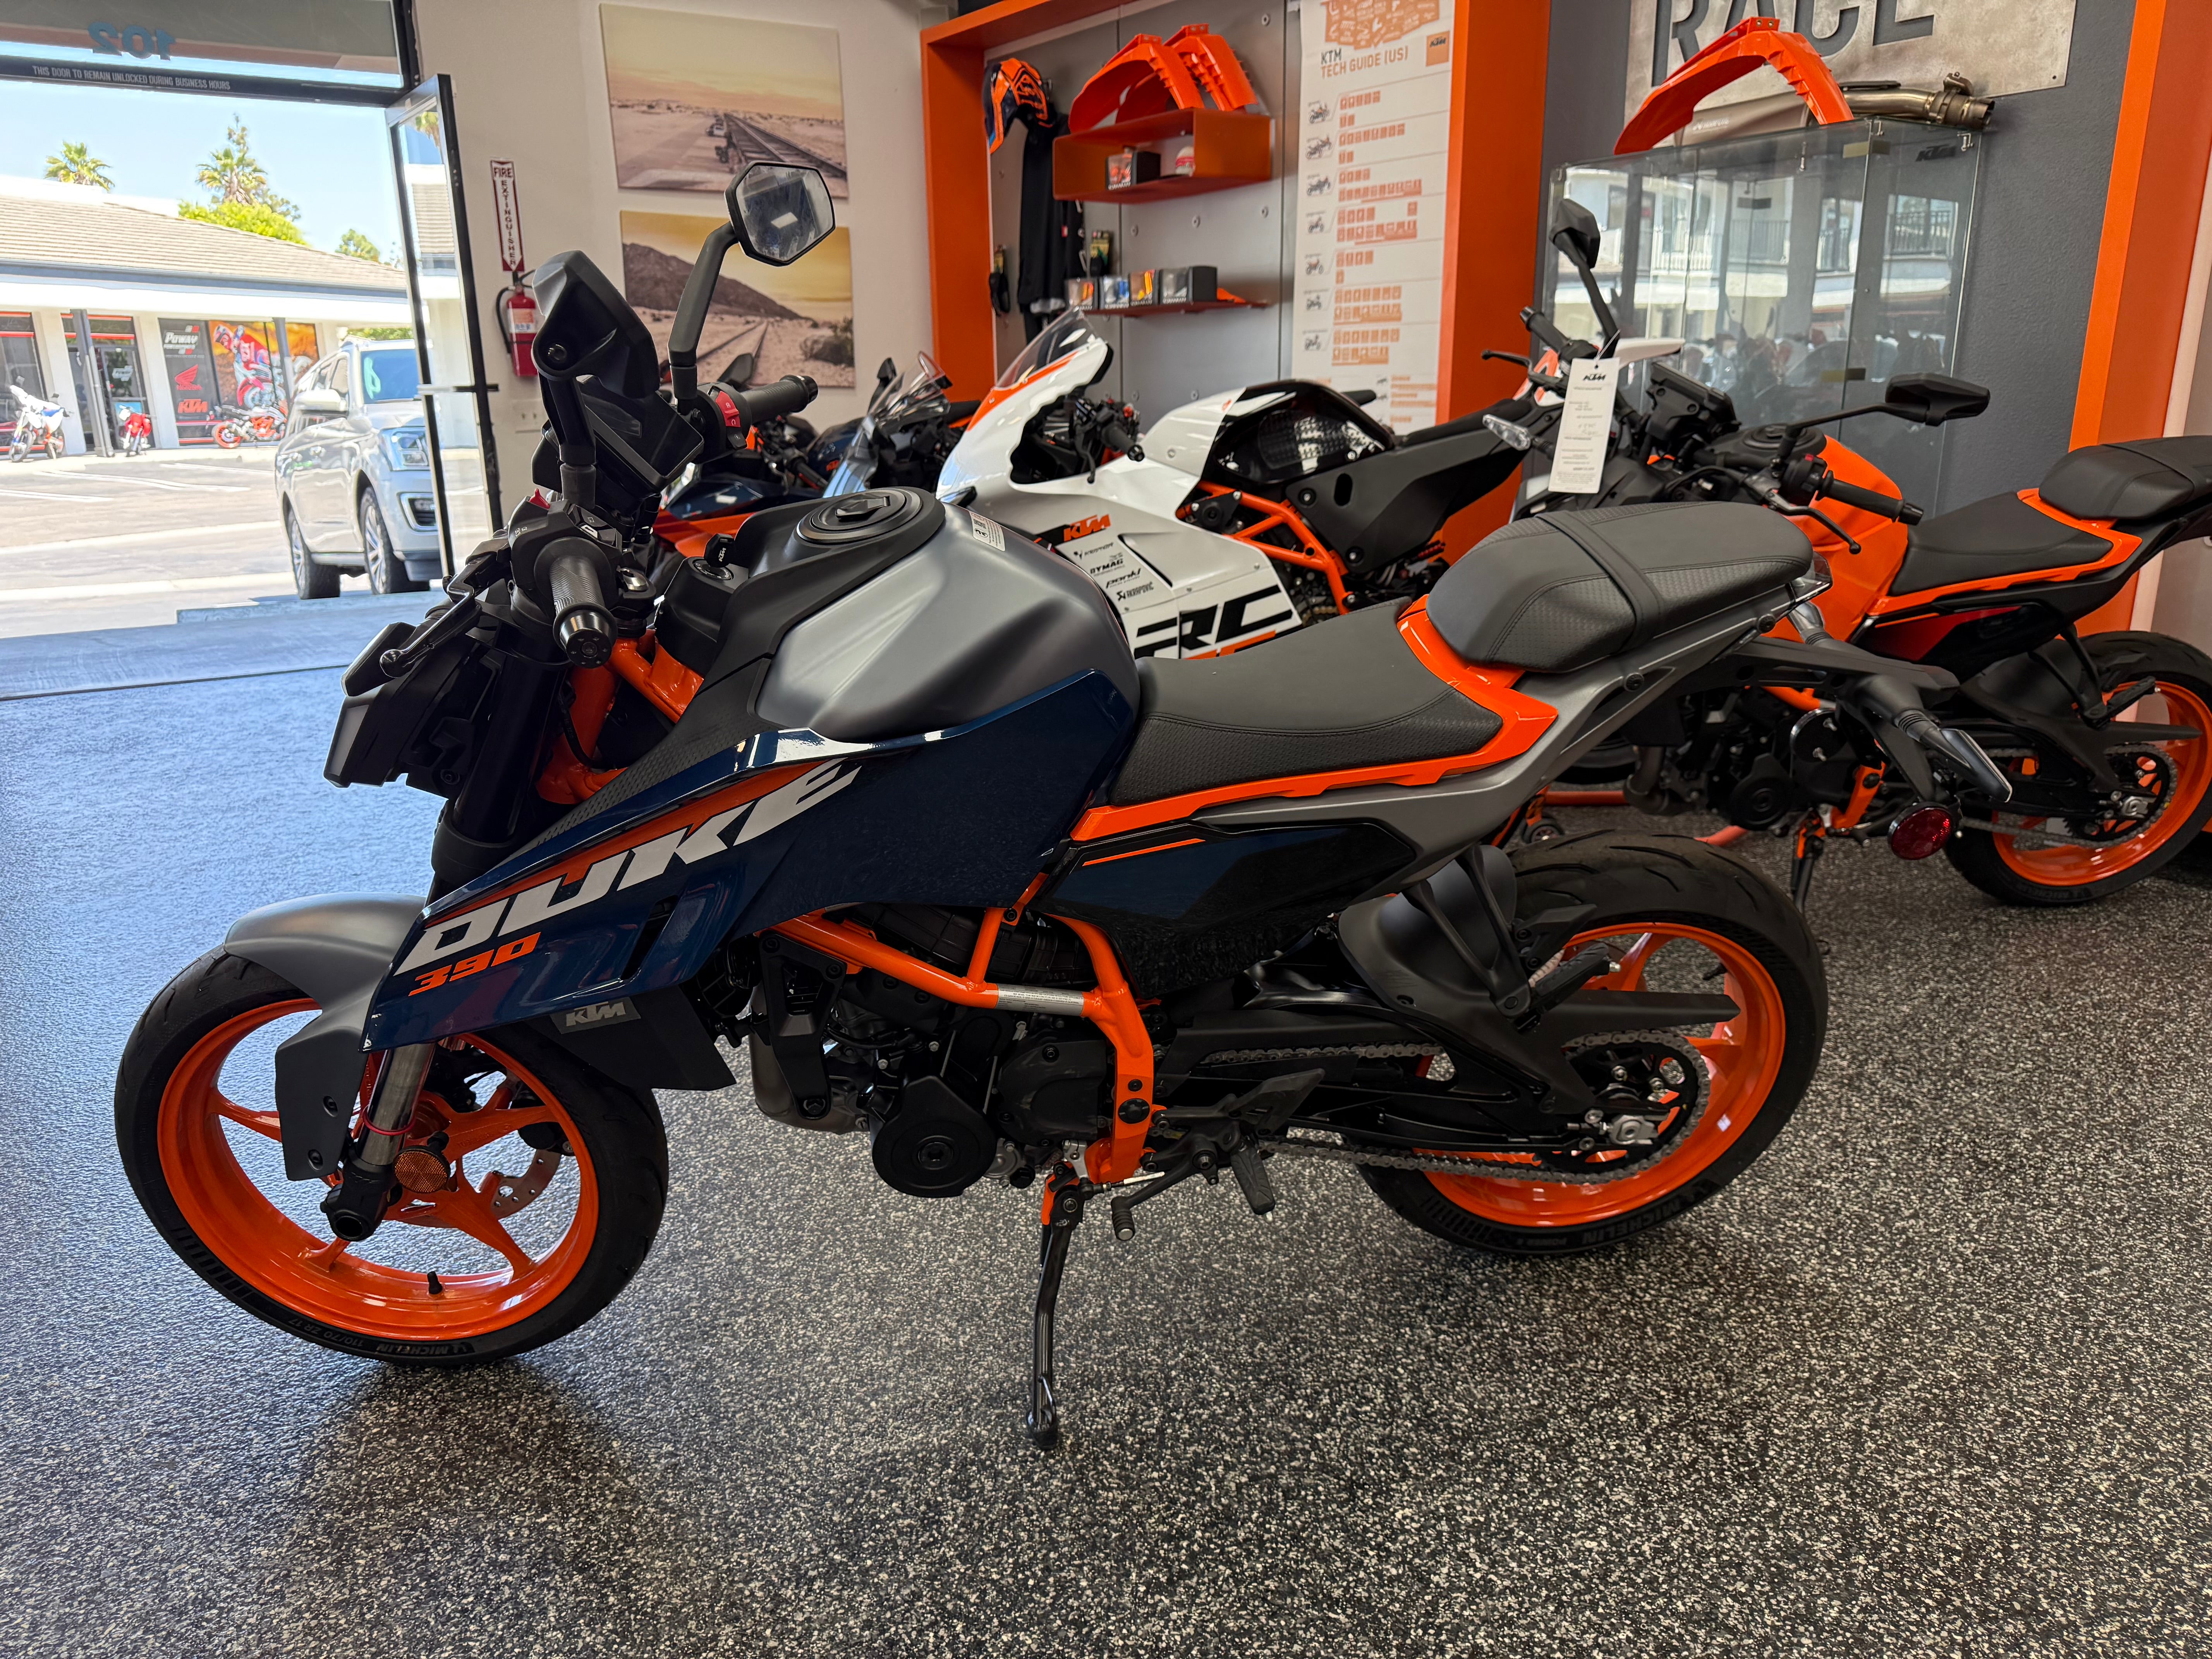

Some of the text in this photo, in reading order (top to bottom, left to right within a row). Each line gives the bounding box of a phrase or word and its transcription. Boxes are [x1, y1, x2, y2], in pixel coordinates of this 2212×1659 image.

[1321, 48, 1342, 64] KTM
[1321, 60, 1346, 79] TECH
[1349, 52, 1381, 72] GUIDE
[32, 65, 230, 90] THIS DOOR TO REMAIN UNLOCKED DURING BUSINESS HOURS
[493, 167, 512, 178] FIRE
[502, 180, 516, 266] EXTINGUISHER
[1583, 372, 1607, 381] KTM
[178, 399, 208, 413] KTM
[1064, 514, 1111, 542] KTM
[718, 547, 726, 562] KTM
[393, 757, 862, 976] DUKE
[408, 932, 541, 996] 390
[565, 998, 626, 1027] KTM
[1581, 1197, 1680, 1245] MICHELIN
[287, 1317, 364, 1347] 110/70 ZR 17
[375, 1343, 449, 1355] MICHELIN
